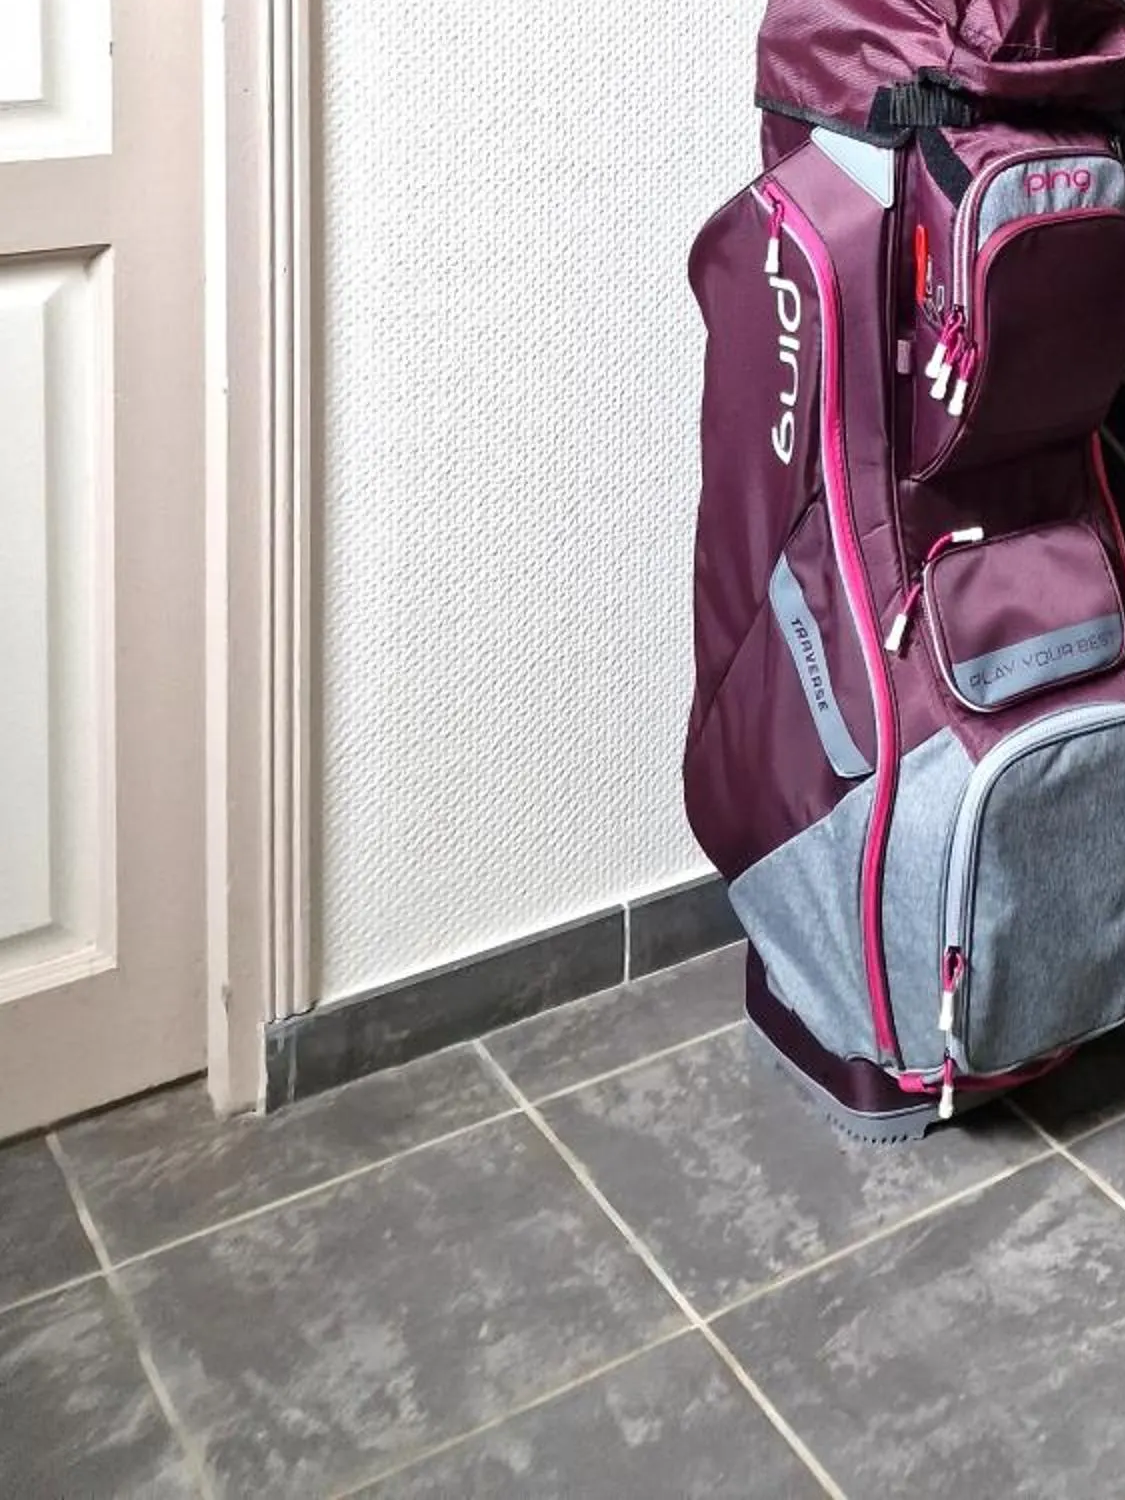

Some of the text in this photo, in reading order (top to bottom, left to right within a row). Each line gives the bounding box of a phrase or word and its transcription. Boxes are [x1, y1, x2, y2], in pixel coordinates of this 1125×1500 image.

[791, 617, 829, 712] TRAVERSE
[969, 629, 1116, 688] PLAY YOUR BEST
